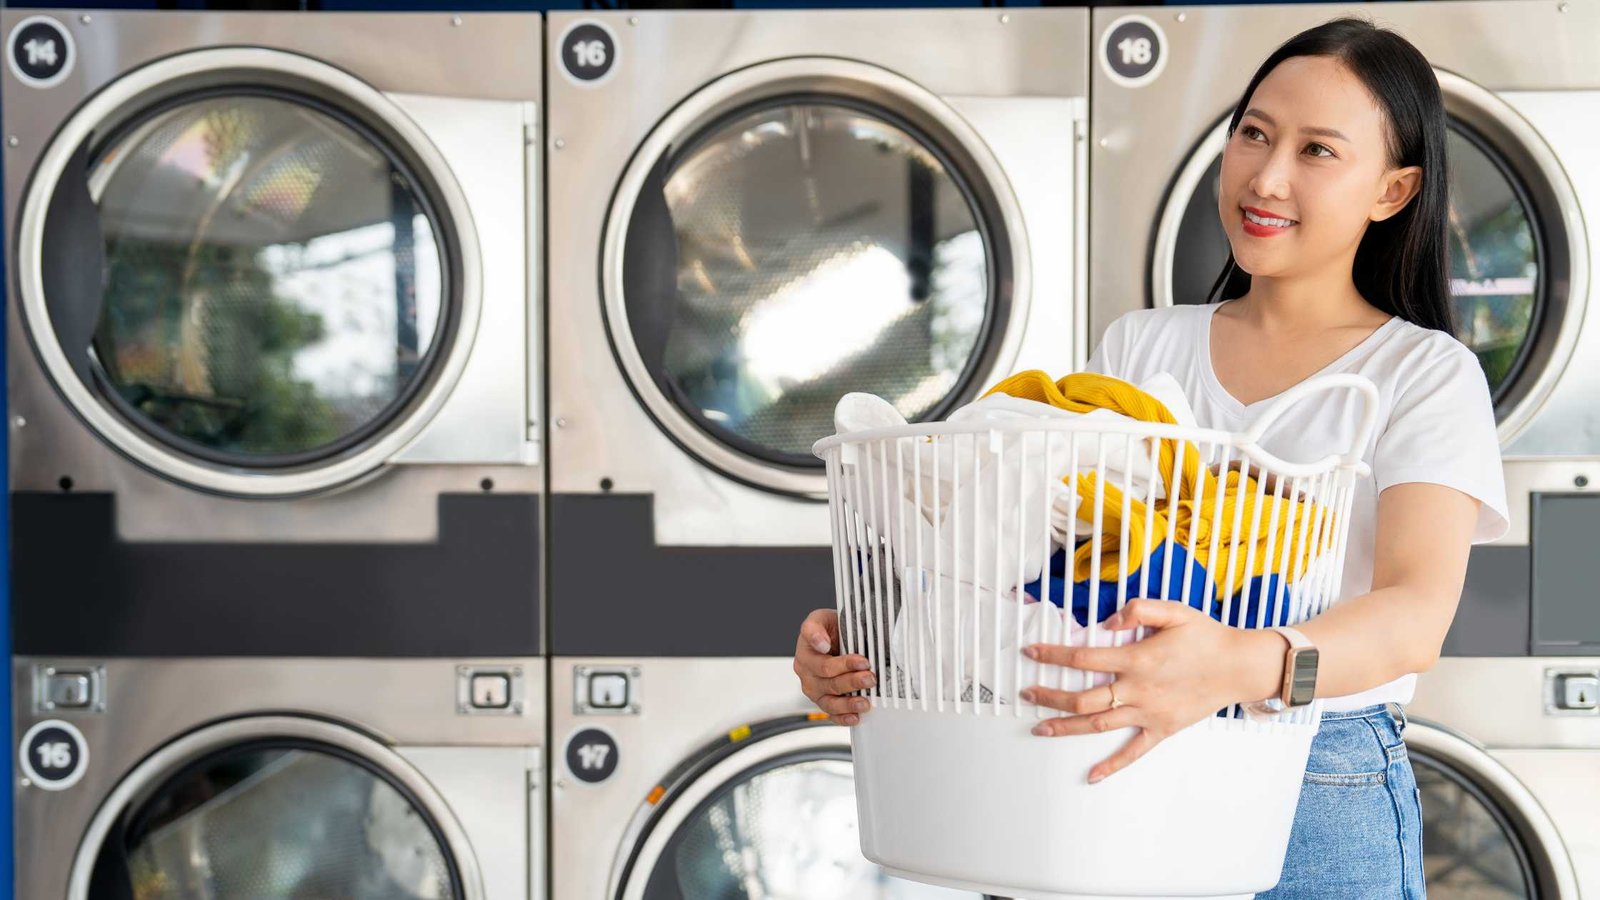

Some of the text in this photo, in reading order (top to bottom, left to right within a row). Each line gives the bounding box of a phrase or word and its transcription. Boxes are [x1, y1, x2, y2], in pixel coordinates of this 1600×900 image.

[24, 39, 57, 65] 14
[572, 39, 606, 66] 16
[1118, 37, 1152, 64] 18
[37, 742, 71, 768] 15
[577, 744, 610, 769] 17
